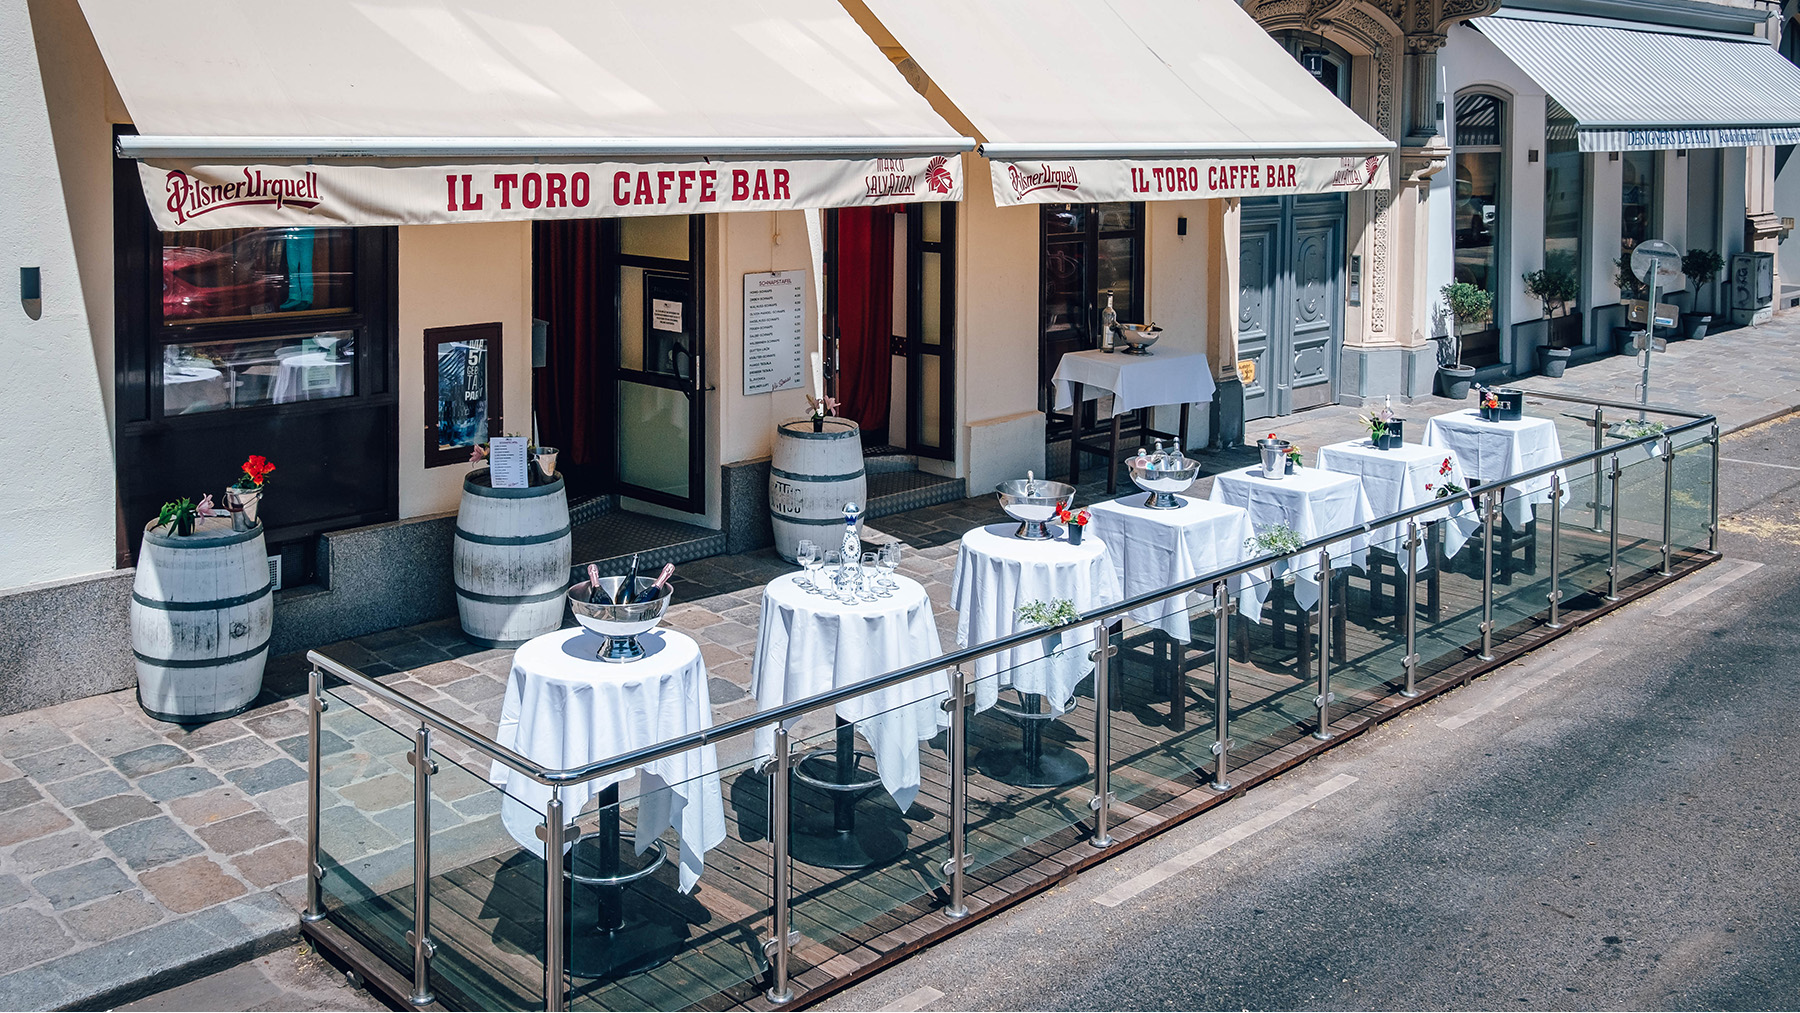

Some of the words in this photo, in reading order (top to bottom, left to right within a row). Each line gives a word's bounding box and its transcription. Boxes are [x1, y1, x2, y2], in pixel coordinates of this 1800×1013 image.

[1310, 57, 1315, 70] 1
[1628, 131, 1676, 146] DESIGNERS
[1678, 130, 1711, 145] DETAILS
[877, 157, 905, 173] MARCO
[446, 174, 484, 212] IL
[494, 171, 590, 210] TORO
[731, 168, 791, 202] BAR
[865, 173, 917, 195] SALVATORI
[1008, 165, 1044, 201] Pilsner
[1041, 163, 1078, 191] Urquell
[1131, 168, 1150, 193] IL
[1152, 166, 1198, 193] TORO
[1266, 164, 1297, 188] BAR
[166, 170, 246, 226] Pilsner
[243, 166, 320, 210] Urquell
